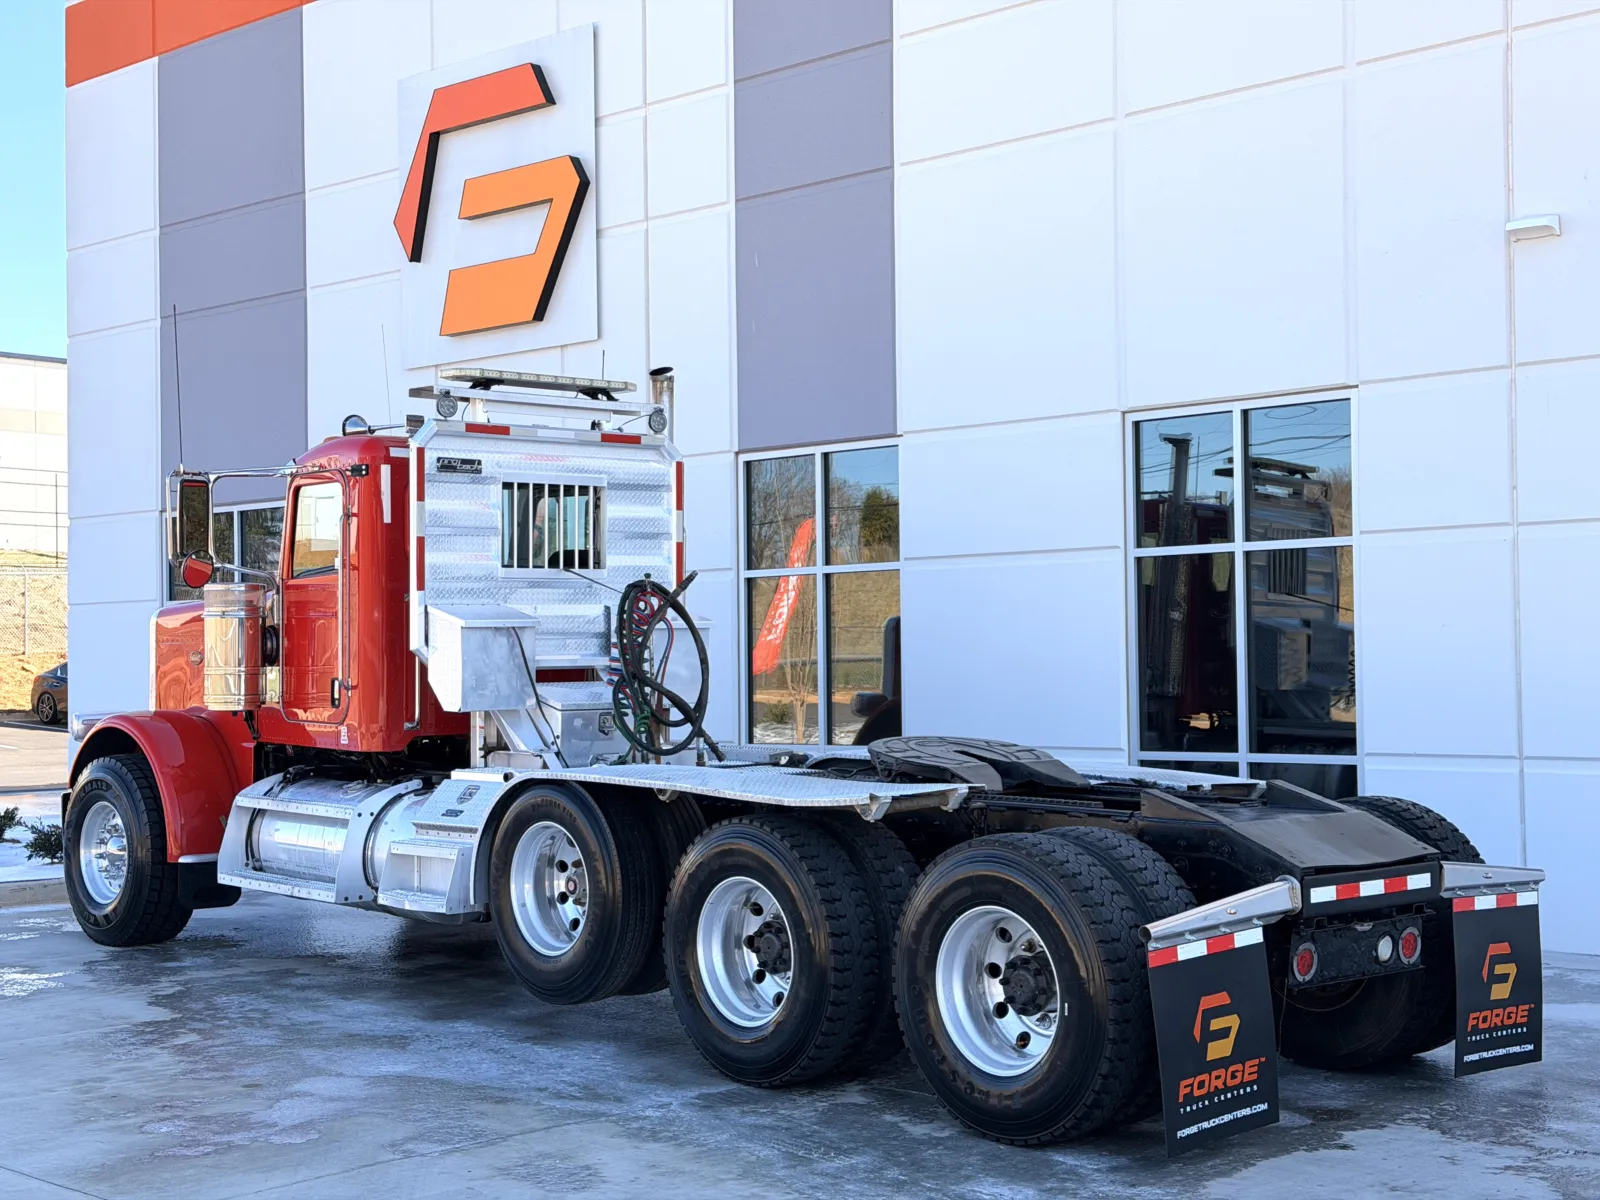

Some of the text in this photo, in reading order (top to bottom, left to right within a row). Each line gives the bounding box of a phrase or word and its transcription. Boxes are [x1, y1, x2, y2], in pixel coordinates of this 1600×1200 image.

[1467, 1004, 1530, 1033] FORGE
[1467, 1027, 1527, 1042] TRUCK CENTERS
[1463, 1044, 1534, 1063] FORGETRUCKCENTERS.COM
[1178, 1058, 1260, 1103] FORGE
[1180, 1084, 1258, 1114] TRUCK CENTERS
[1176, 1102, 1268, 1140] FORGETRUCKCENTERS.COM
